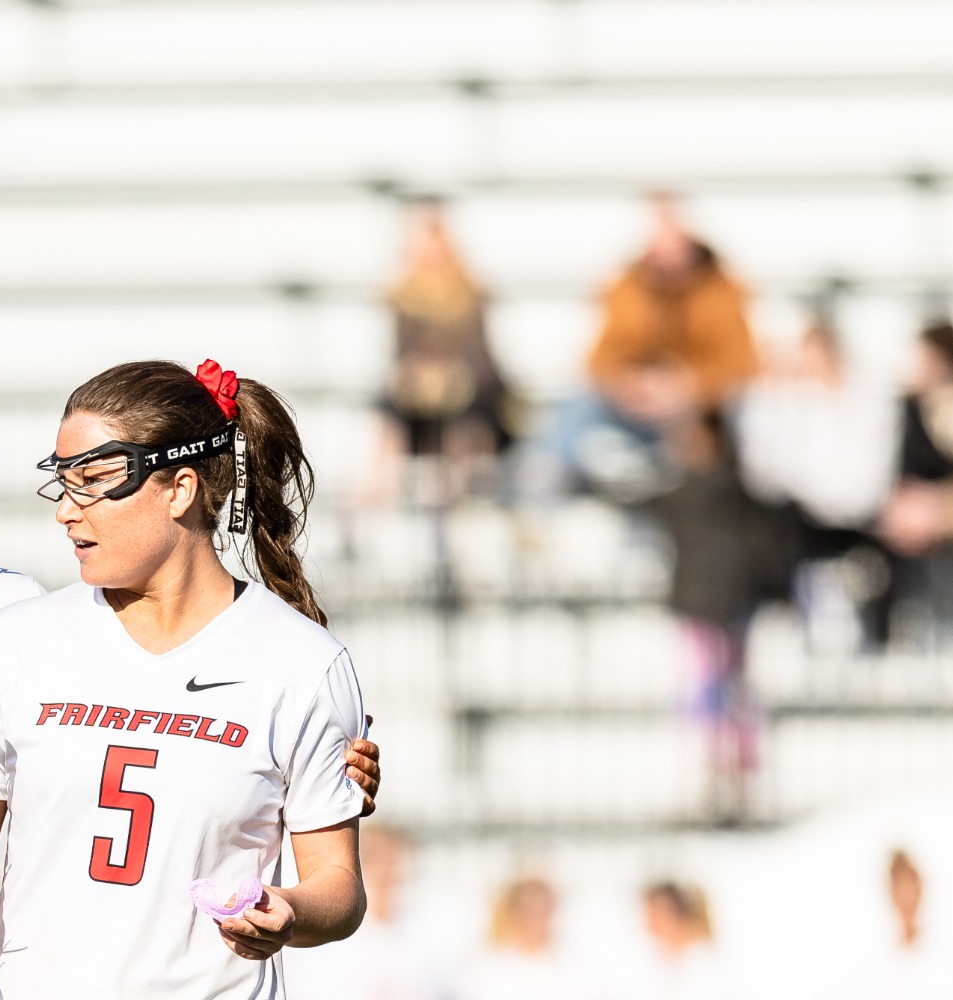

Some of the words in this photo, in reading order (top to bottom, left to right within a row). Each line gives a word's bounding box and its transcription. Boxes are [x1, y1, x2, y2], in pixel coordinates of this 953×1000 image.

[167, 441, 206, 460] GAIT
[212, 431, 229, 448] GAI
[35, 702, 249, 748] FAIRFIELD
[89, 744, 159, 887] 5
